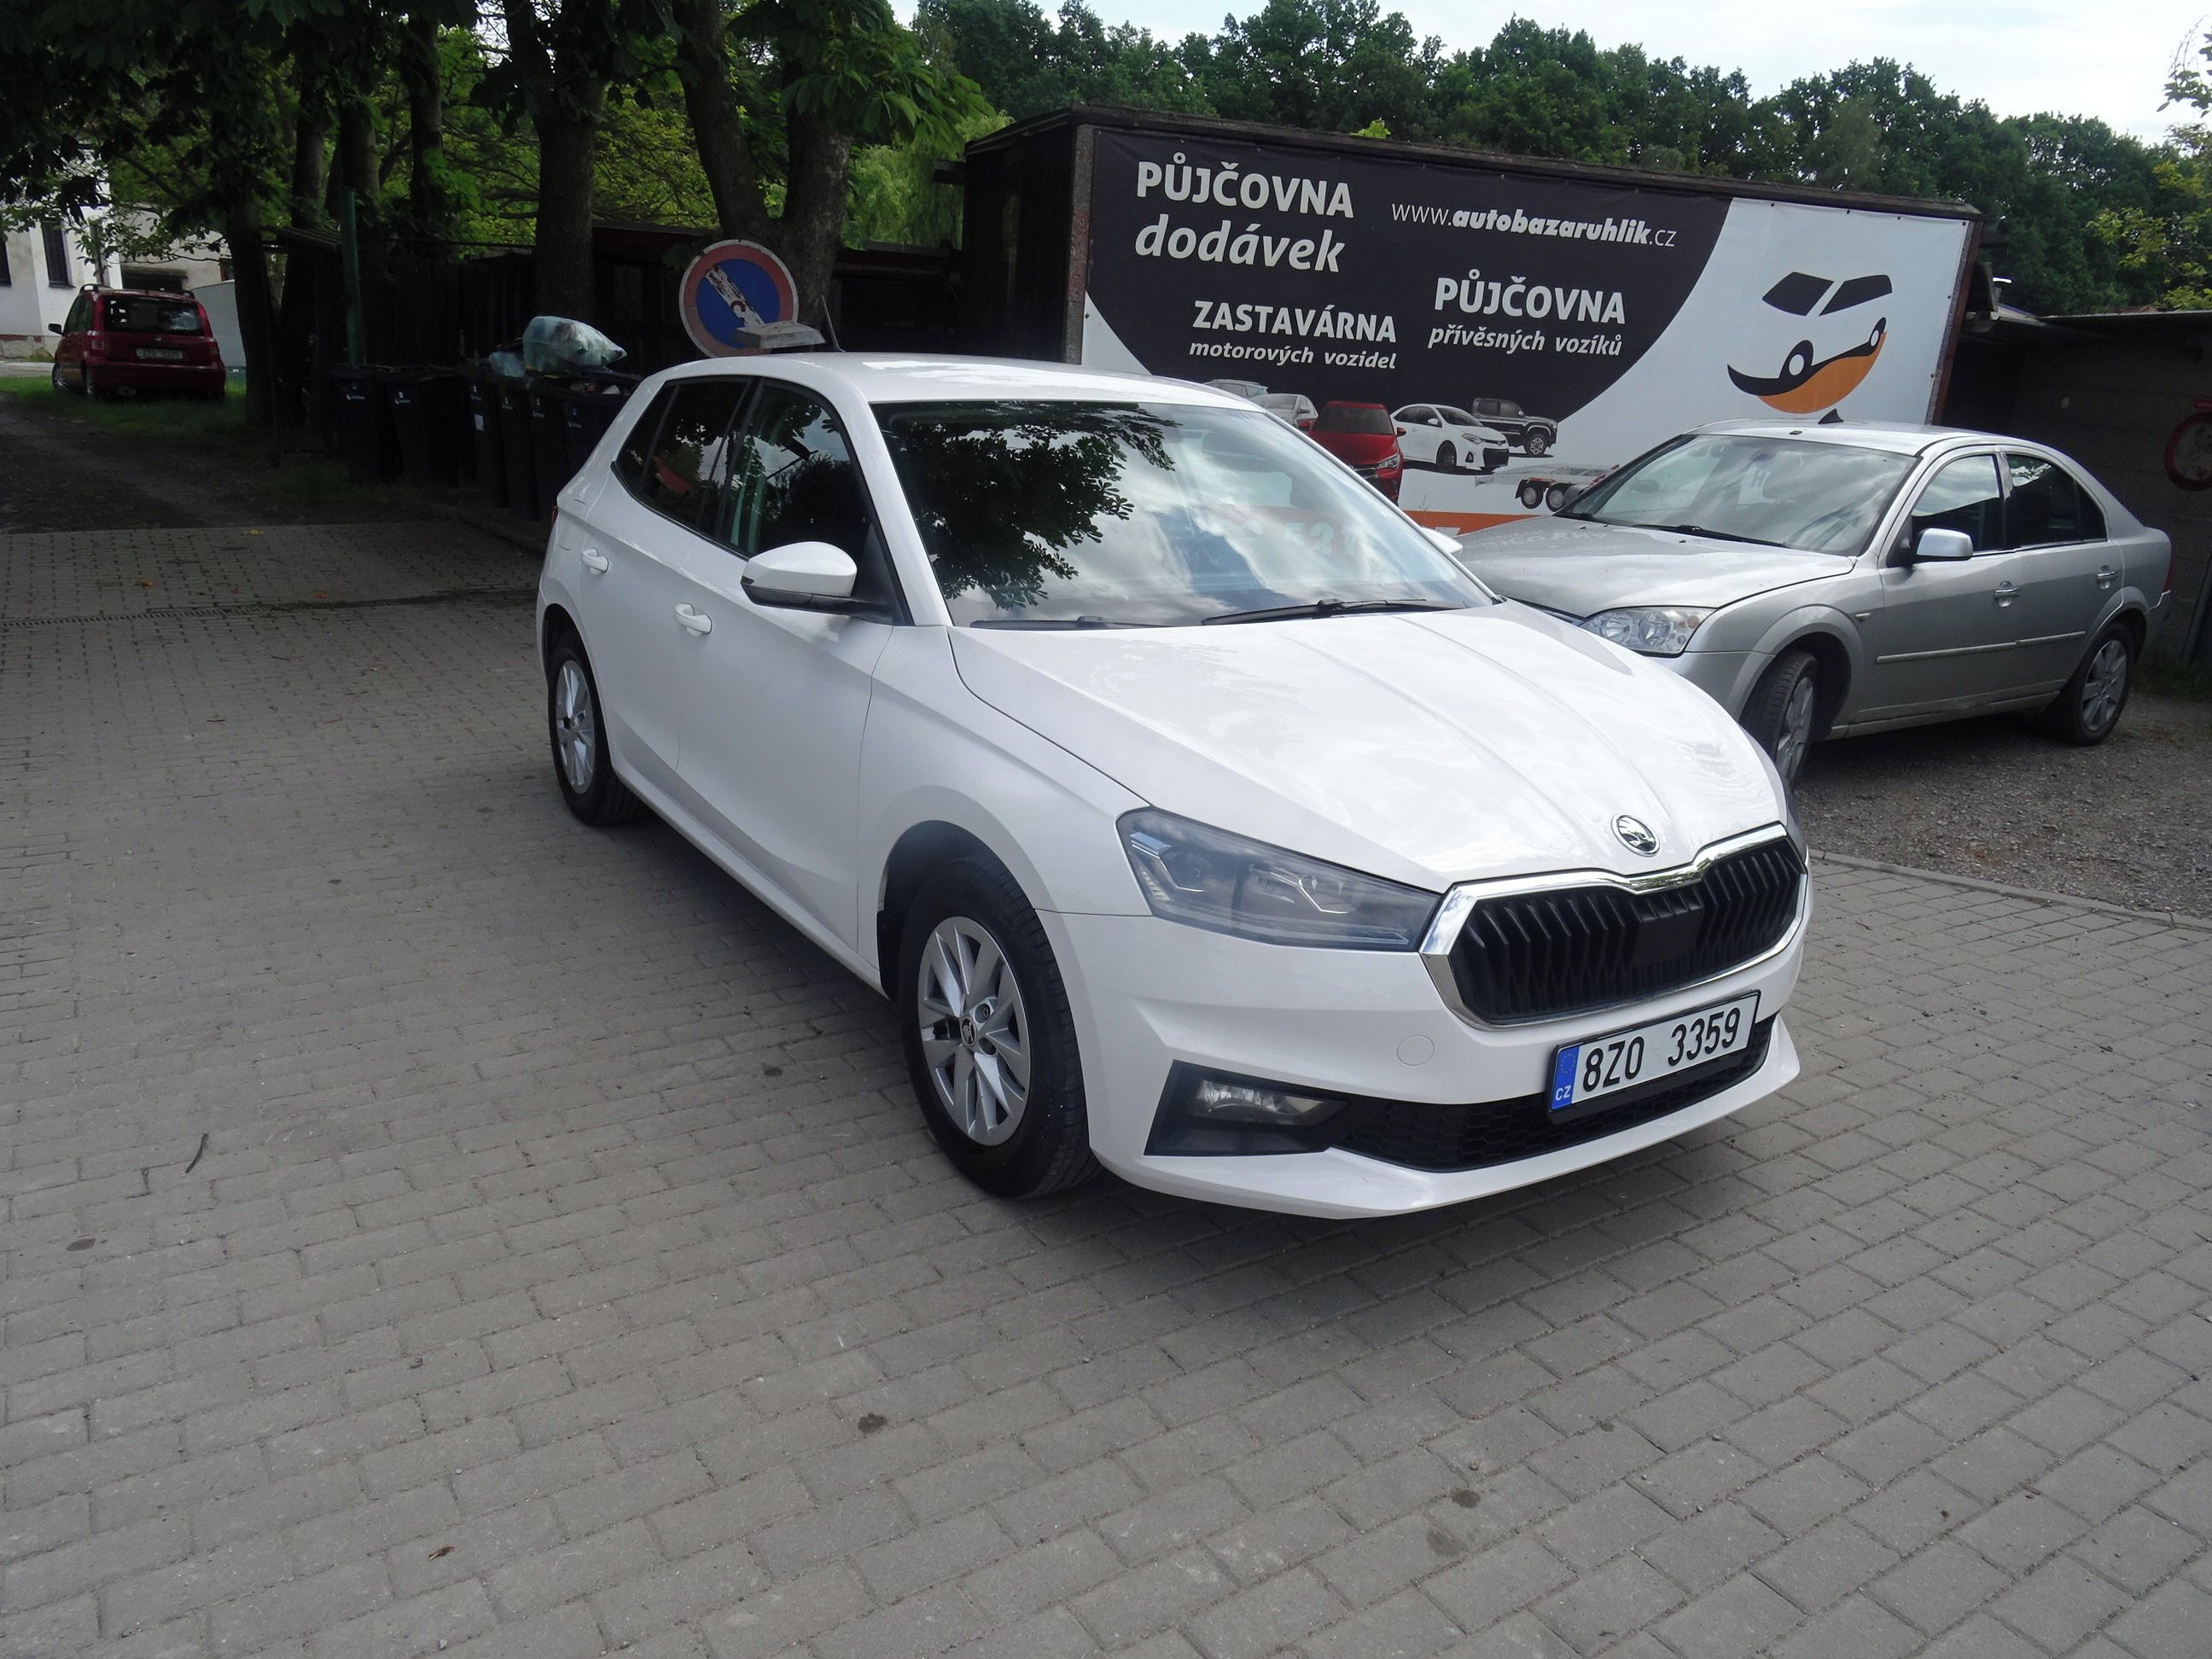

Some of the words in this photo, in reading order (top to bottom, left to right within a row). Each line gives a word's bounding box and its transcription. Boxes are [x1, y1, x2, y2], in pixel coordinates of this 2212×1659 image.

[1138, 153, 1353, 218] PŮJČOVNA
[1136, 214, 1345, 272] dodávek
[1392, 204, 1676, 247] www.autobazaruhlik.cz
[1435, 269, 1625, 323] PŮJČOVNA
[1193, 300, 1396, 342] ZASTAVÁRNA
[1428, 323, 1545, 354] přívěsných
[1557, 335, 1622, 356] vozíků
[1190, 342, 1313, 366] motorových
[1325, 351, 1396, 370] vozidel
[1583, 1037, 1644, 1092] 8Z0
[1668, 1008, 1740, 1067] 3359
[1554, 1085, 1571, 1101] CZ
